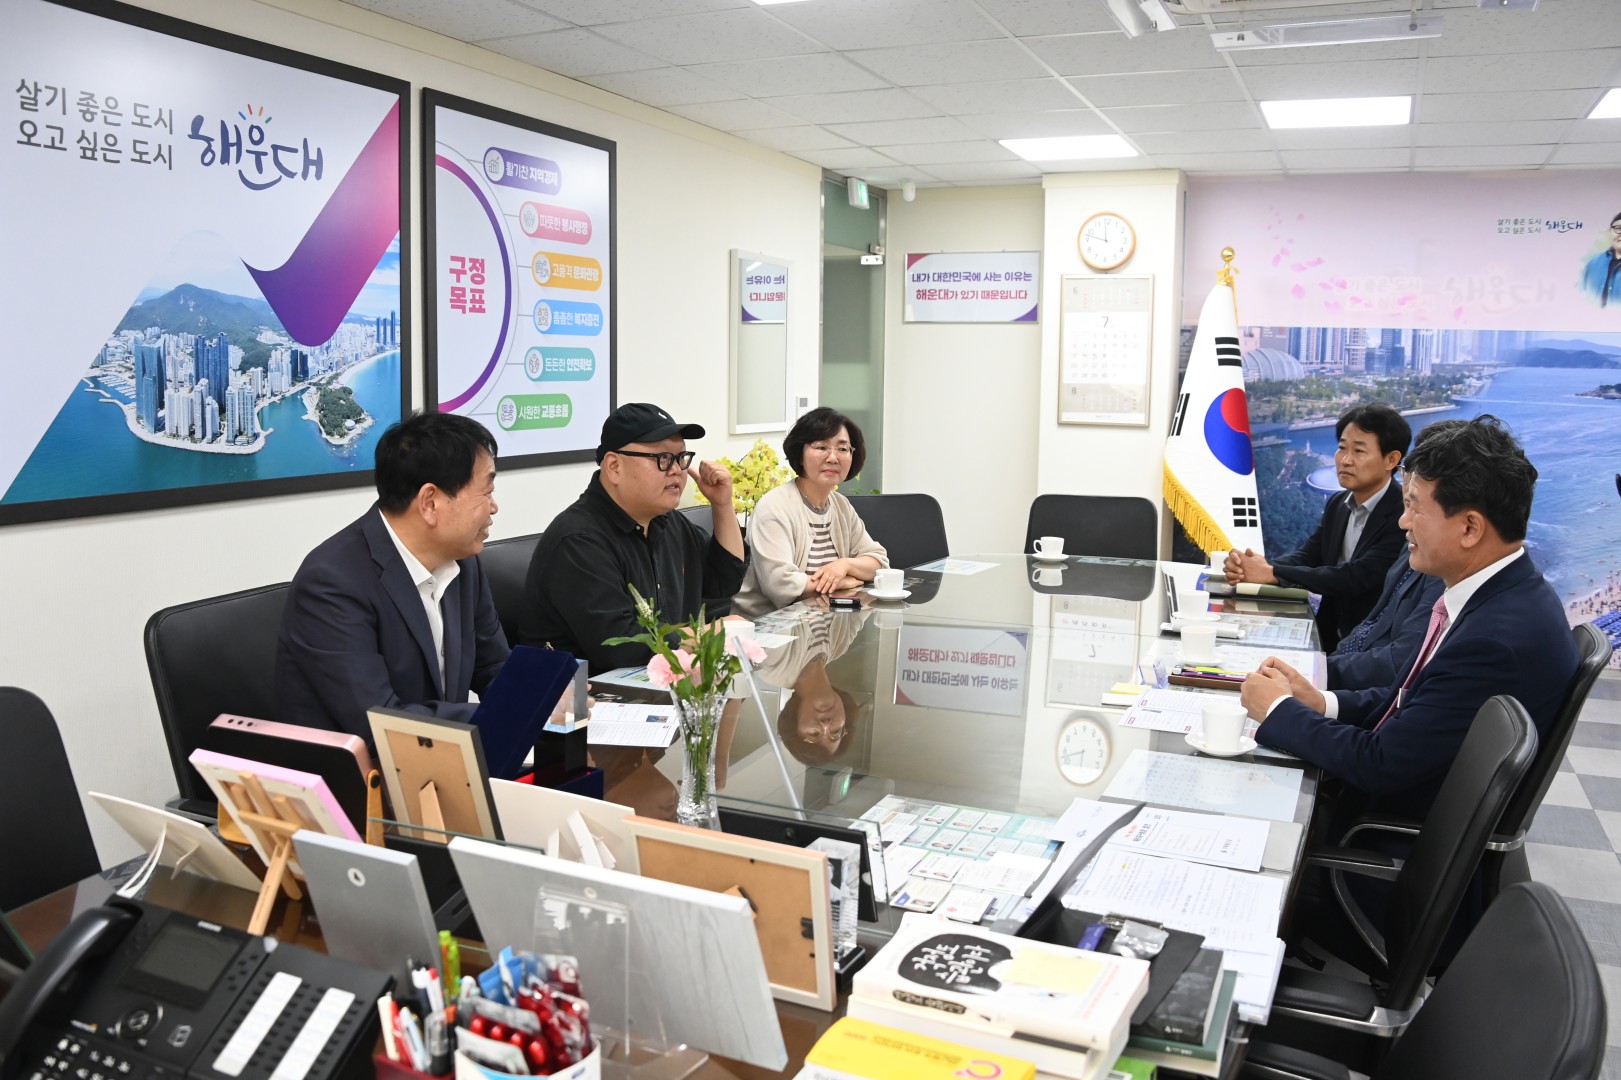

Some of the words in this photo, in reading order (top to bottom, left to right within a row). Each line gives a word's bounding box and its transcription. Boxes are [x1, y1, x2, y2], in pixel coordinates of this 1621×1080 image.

[16, 78, 67, 115] 살기
[76, 90, 123, 126] 좋은
[131, 102, 173, 135] 도시
[16, 119, 67, 151] 오고
[76, 129, 123, 164] 싶은
[130, 138, 173, 170] 도시
[187, 113, 324, 190] 해운대
[505, 161, 529, 180] 활기찬
[529, 166, 558, 186] 지역경제
[539, 214, 561, 231] 따뜻한
[1545, 219, 1583, 233] 해운대
[449, 255, 486, 286] 구정
[911, 272, 930, 283] 내가
[932, 271, 981, 283] 대한민국에
[984, 271, 1002, 282] 사는
[1004, 271, 1032, 282] 이유는
[449, 286, 486, 315] 목표
[915, 288, 959, 301] 해운대가
[960, 289, 979, 300] 있기
[980, 289, 1028, 300] 때문입니다
[1101, 316, 1109, 328] 7
[544, 357, 566, 372] 든든한
[518, 405, 541, 420] 시원한
[541, 404, 569, 419] 교통흐름
